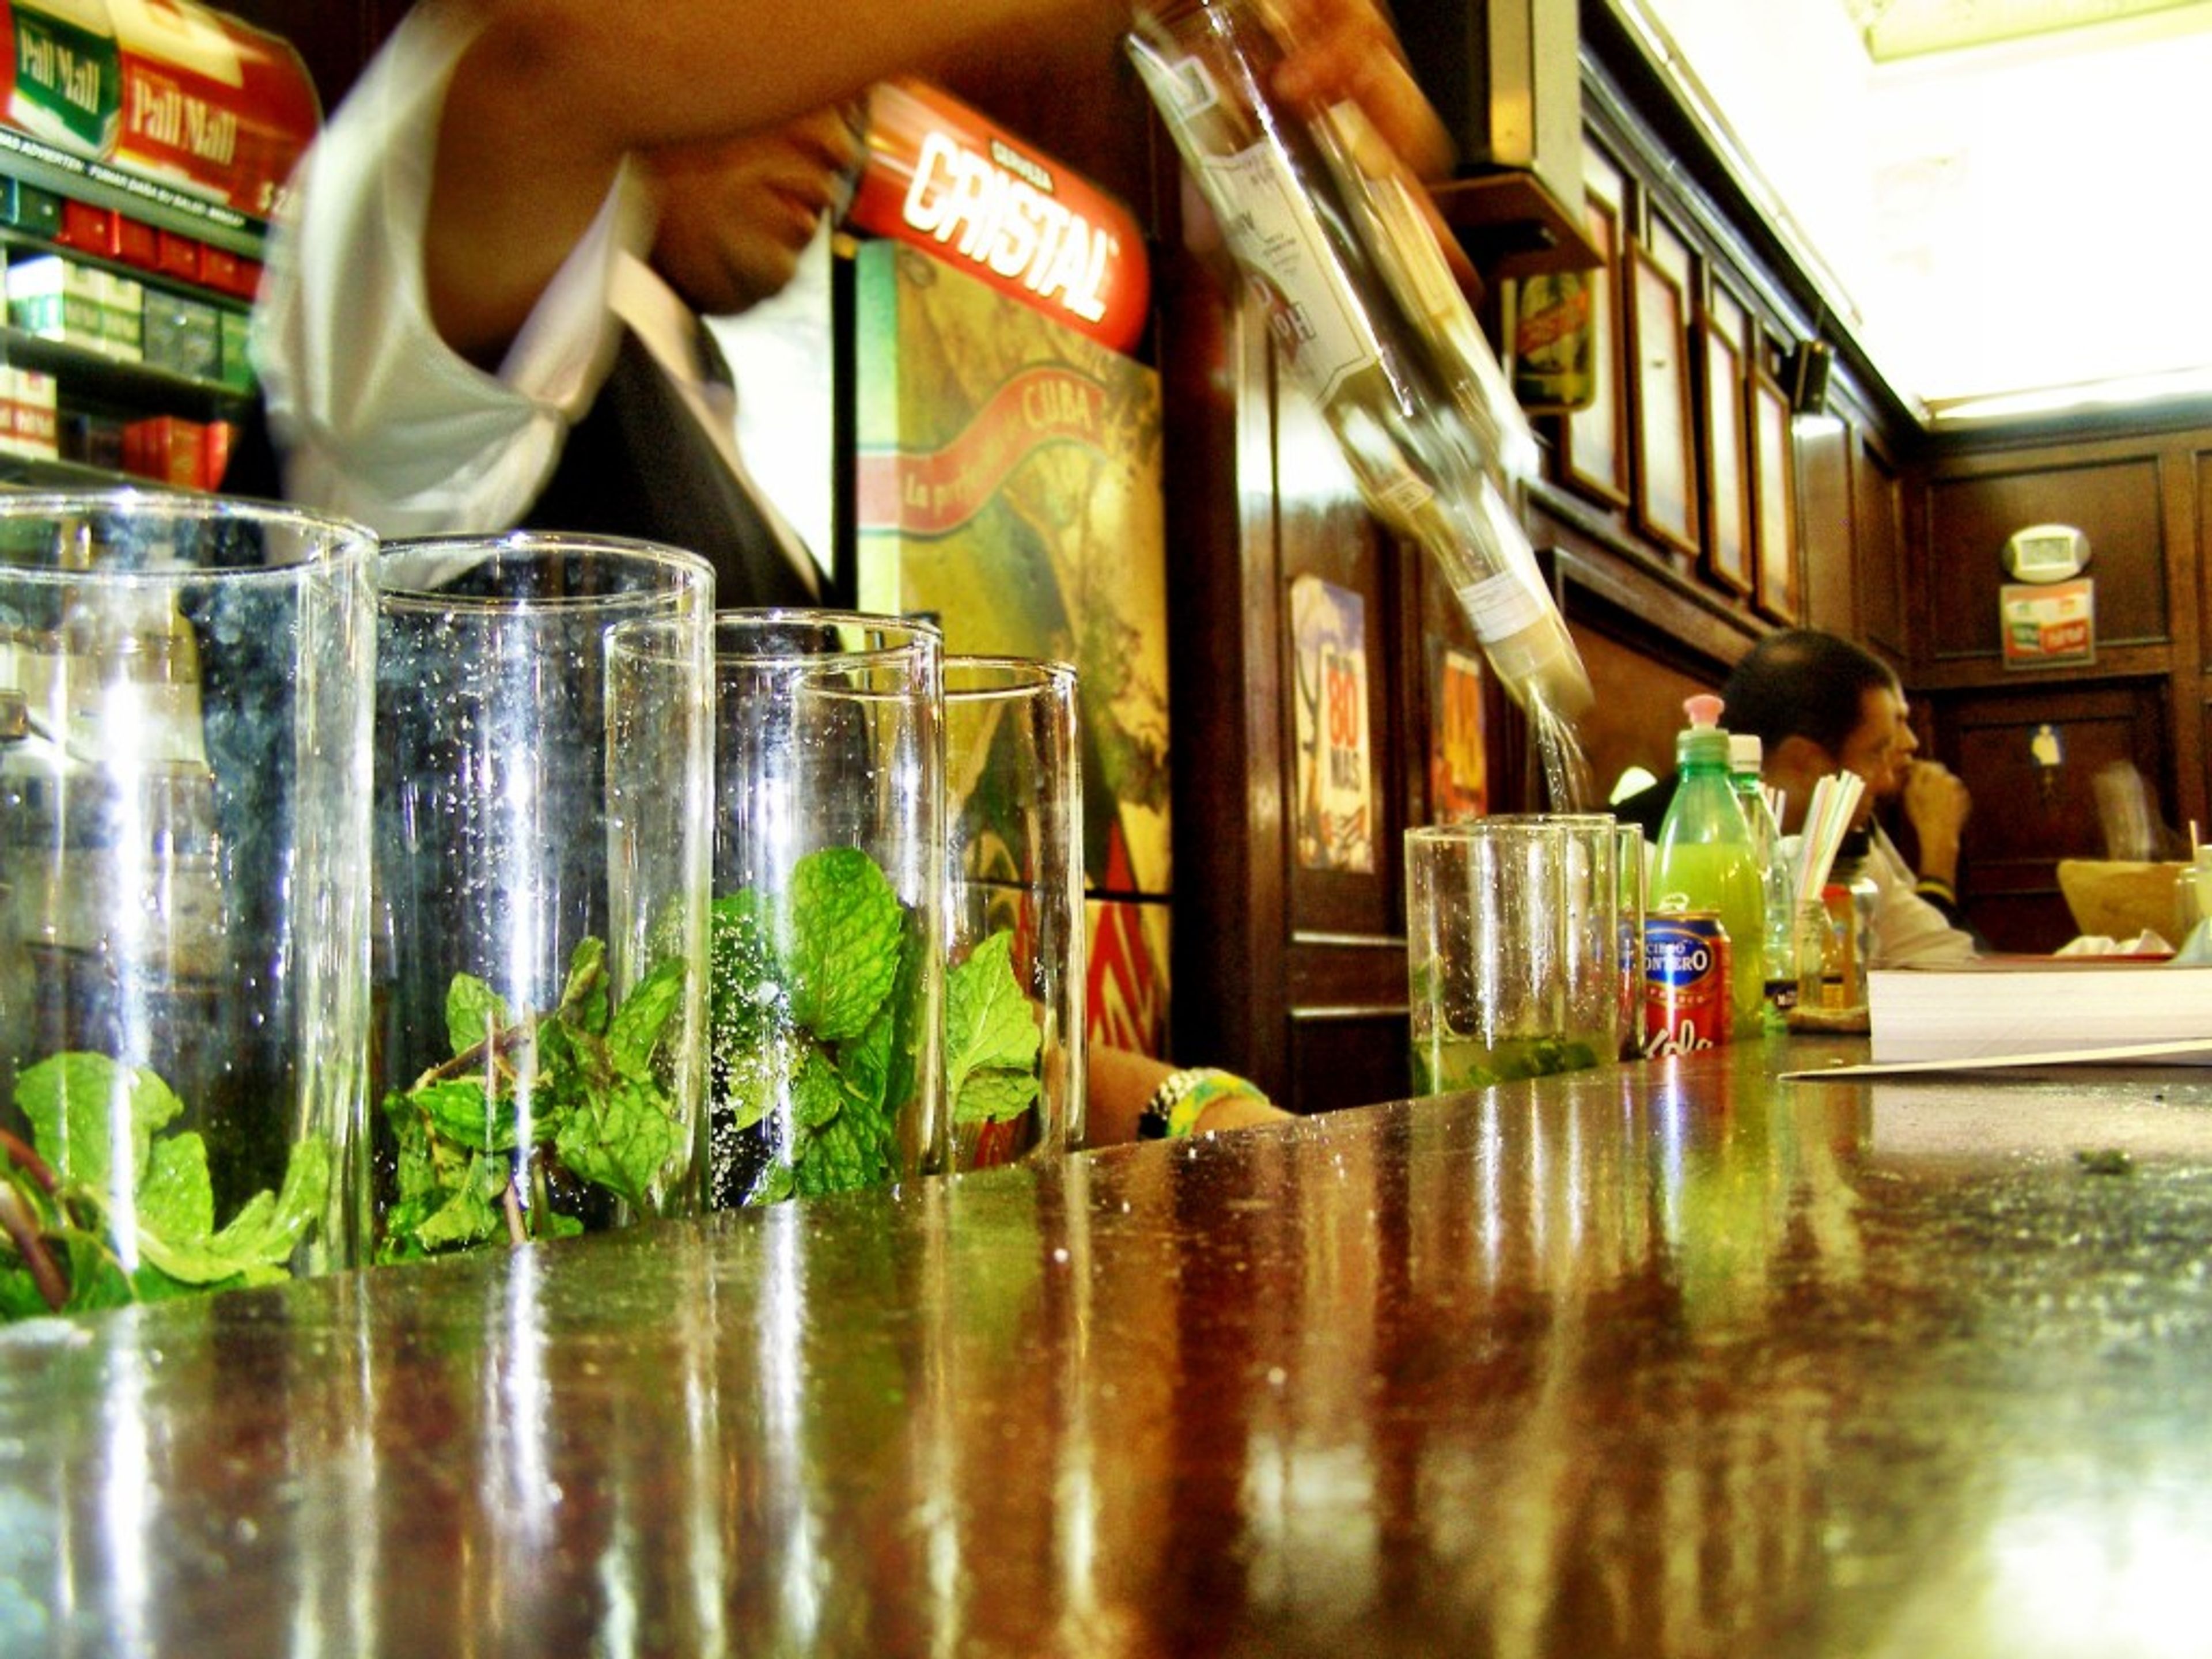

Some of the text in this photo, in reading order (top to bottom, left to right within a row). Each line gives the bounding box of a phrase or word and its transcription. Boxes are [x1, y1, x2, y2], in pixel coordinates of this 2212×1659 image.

[21, 28, 55, 89] Pall
[131, 77, 182, 146] Pall
[903, 130, 1108, 324] CRISTAL
[1022, 380, 1092, 431] CUBA
[1328, 666, 1357, 748] 80
[1643, 949, 1708, 971] ONTERO
